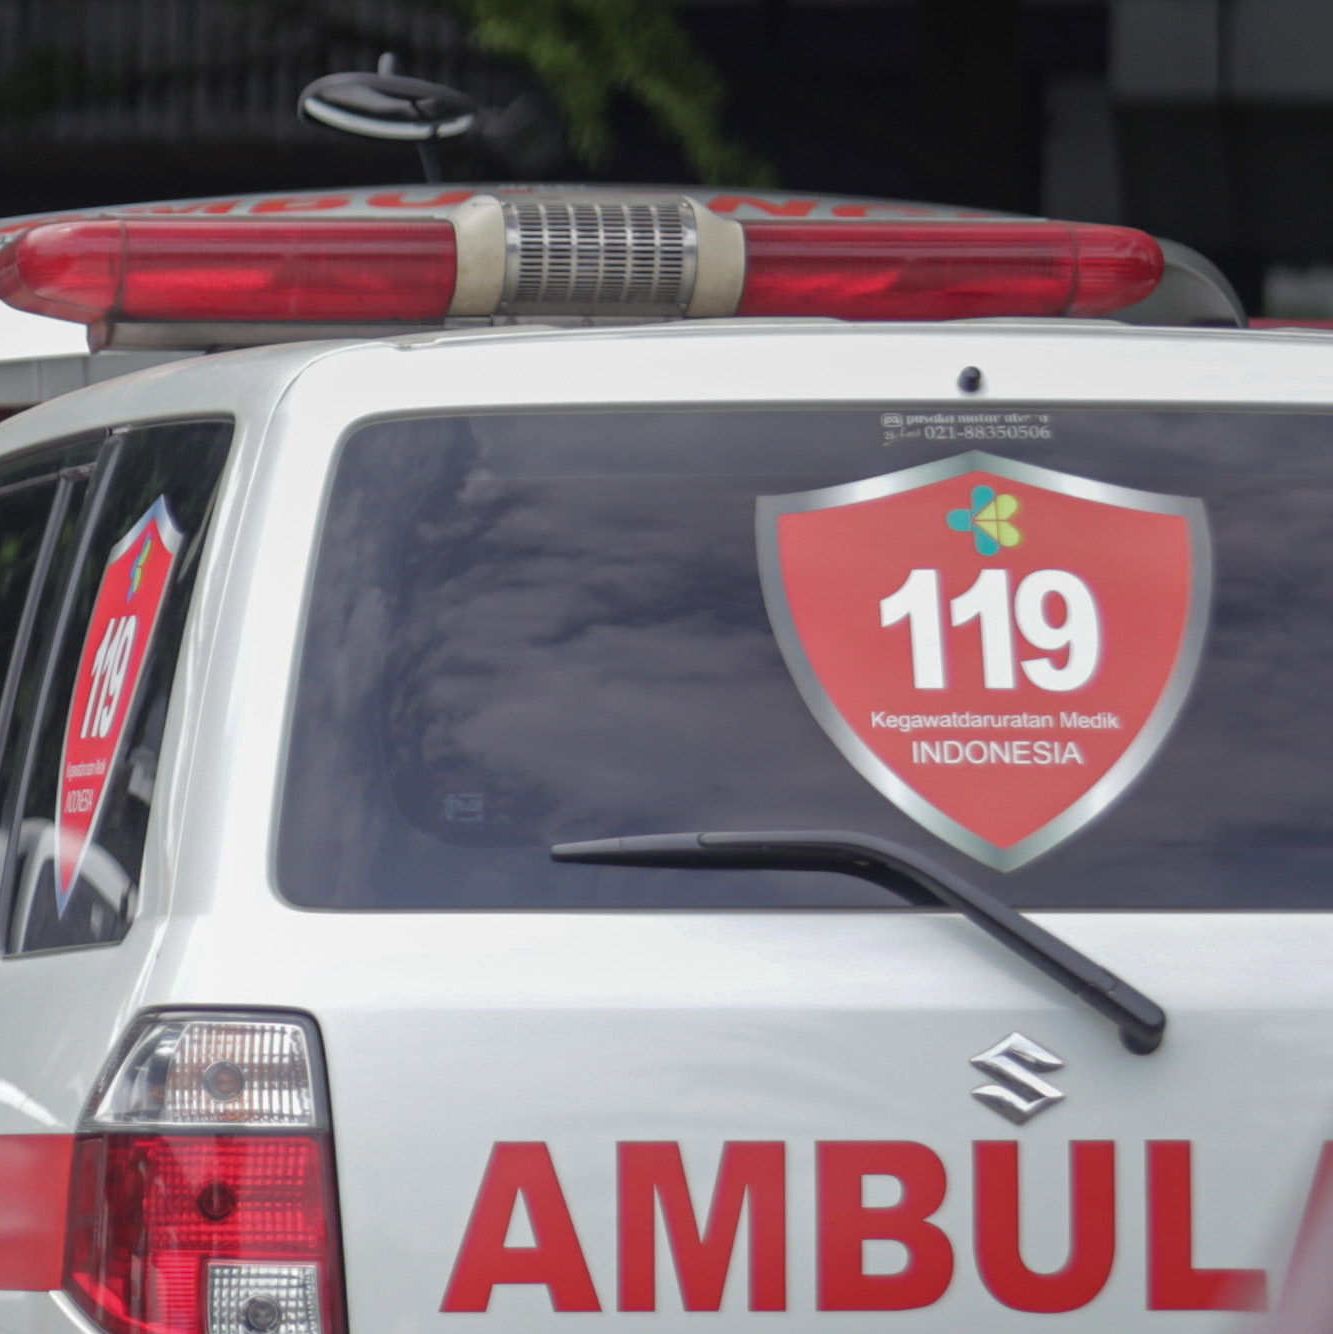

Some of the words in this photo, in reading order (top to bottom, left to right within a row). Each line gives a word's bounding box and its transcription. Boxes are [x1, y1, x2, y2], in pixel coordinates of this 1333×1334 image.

[958, 413, 1000, 424] motor
[924, 425, 1051, 439] 021-88350506
[880, 569, 1101, 692] 119
[80, 614, 138, 739] 119
[870, 711, 1054, 732] Kegawatdaruratan
[1060, 711, 1120, 729] Medik
[912, 740, 1083, 764] INDONESIA
